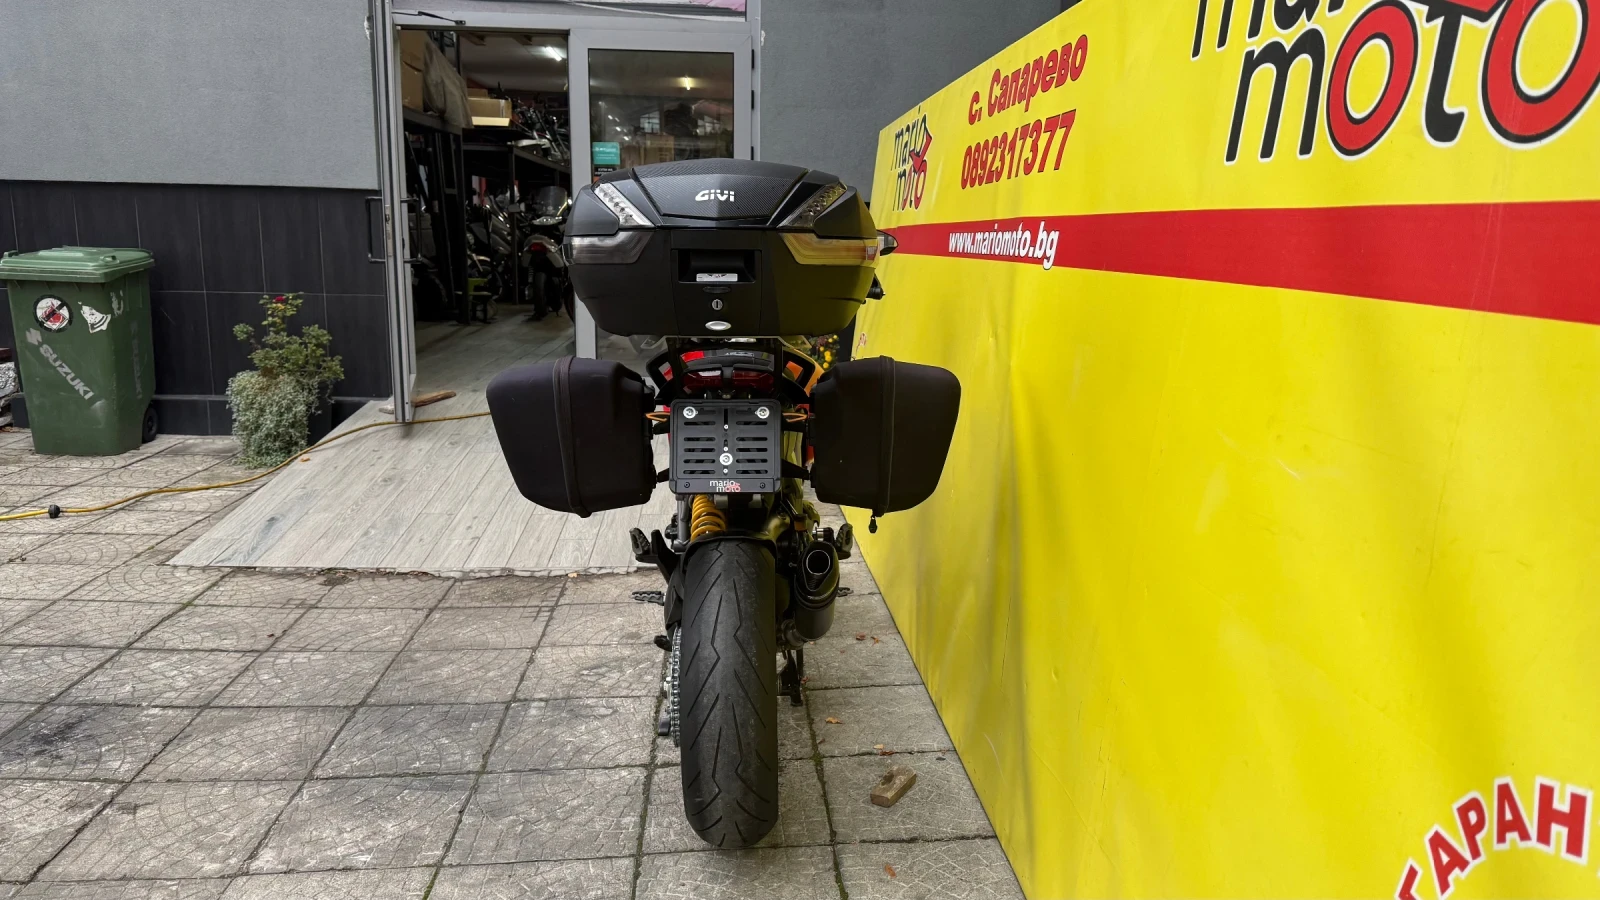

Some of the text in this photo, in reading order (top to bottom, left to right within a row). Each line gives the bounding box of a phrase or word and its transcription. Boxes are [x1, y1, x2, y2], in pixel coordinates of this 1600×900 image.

[987, 34, 1088, 117] Сапарево
[960, 109, 1077, 190] 0892317377
[695, 189, 735, 202] GIVI
[948, 221, 1060, 271] www.mariomoto.bg
[39, 343, 95, 400] SUZUKI
